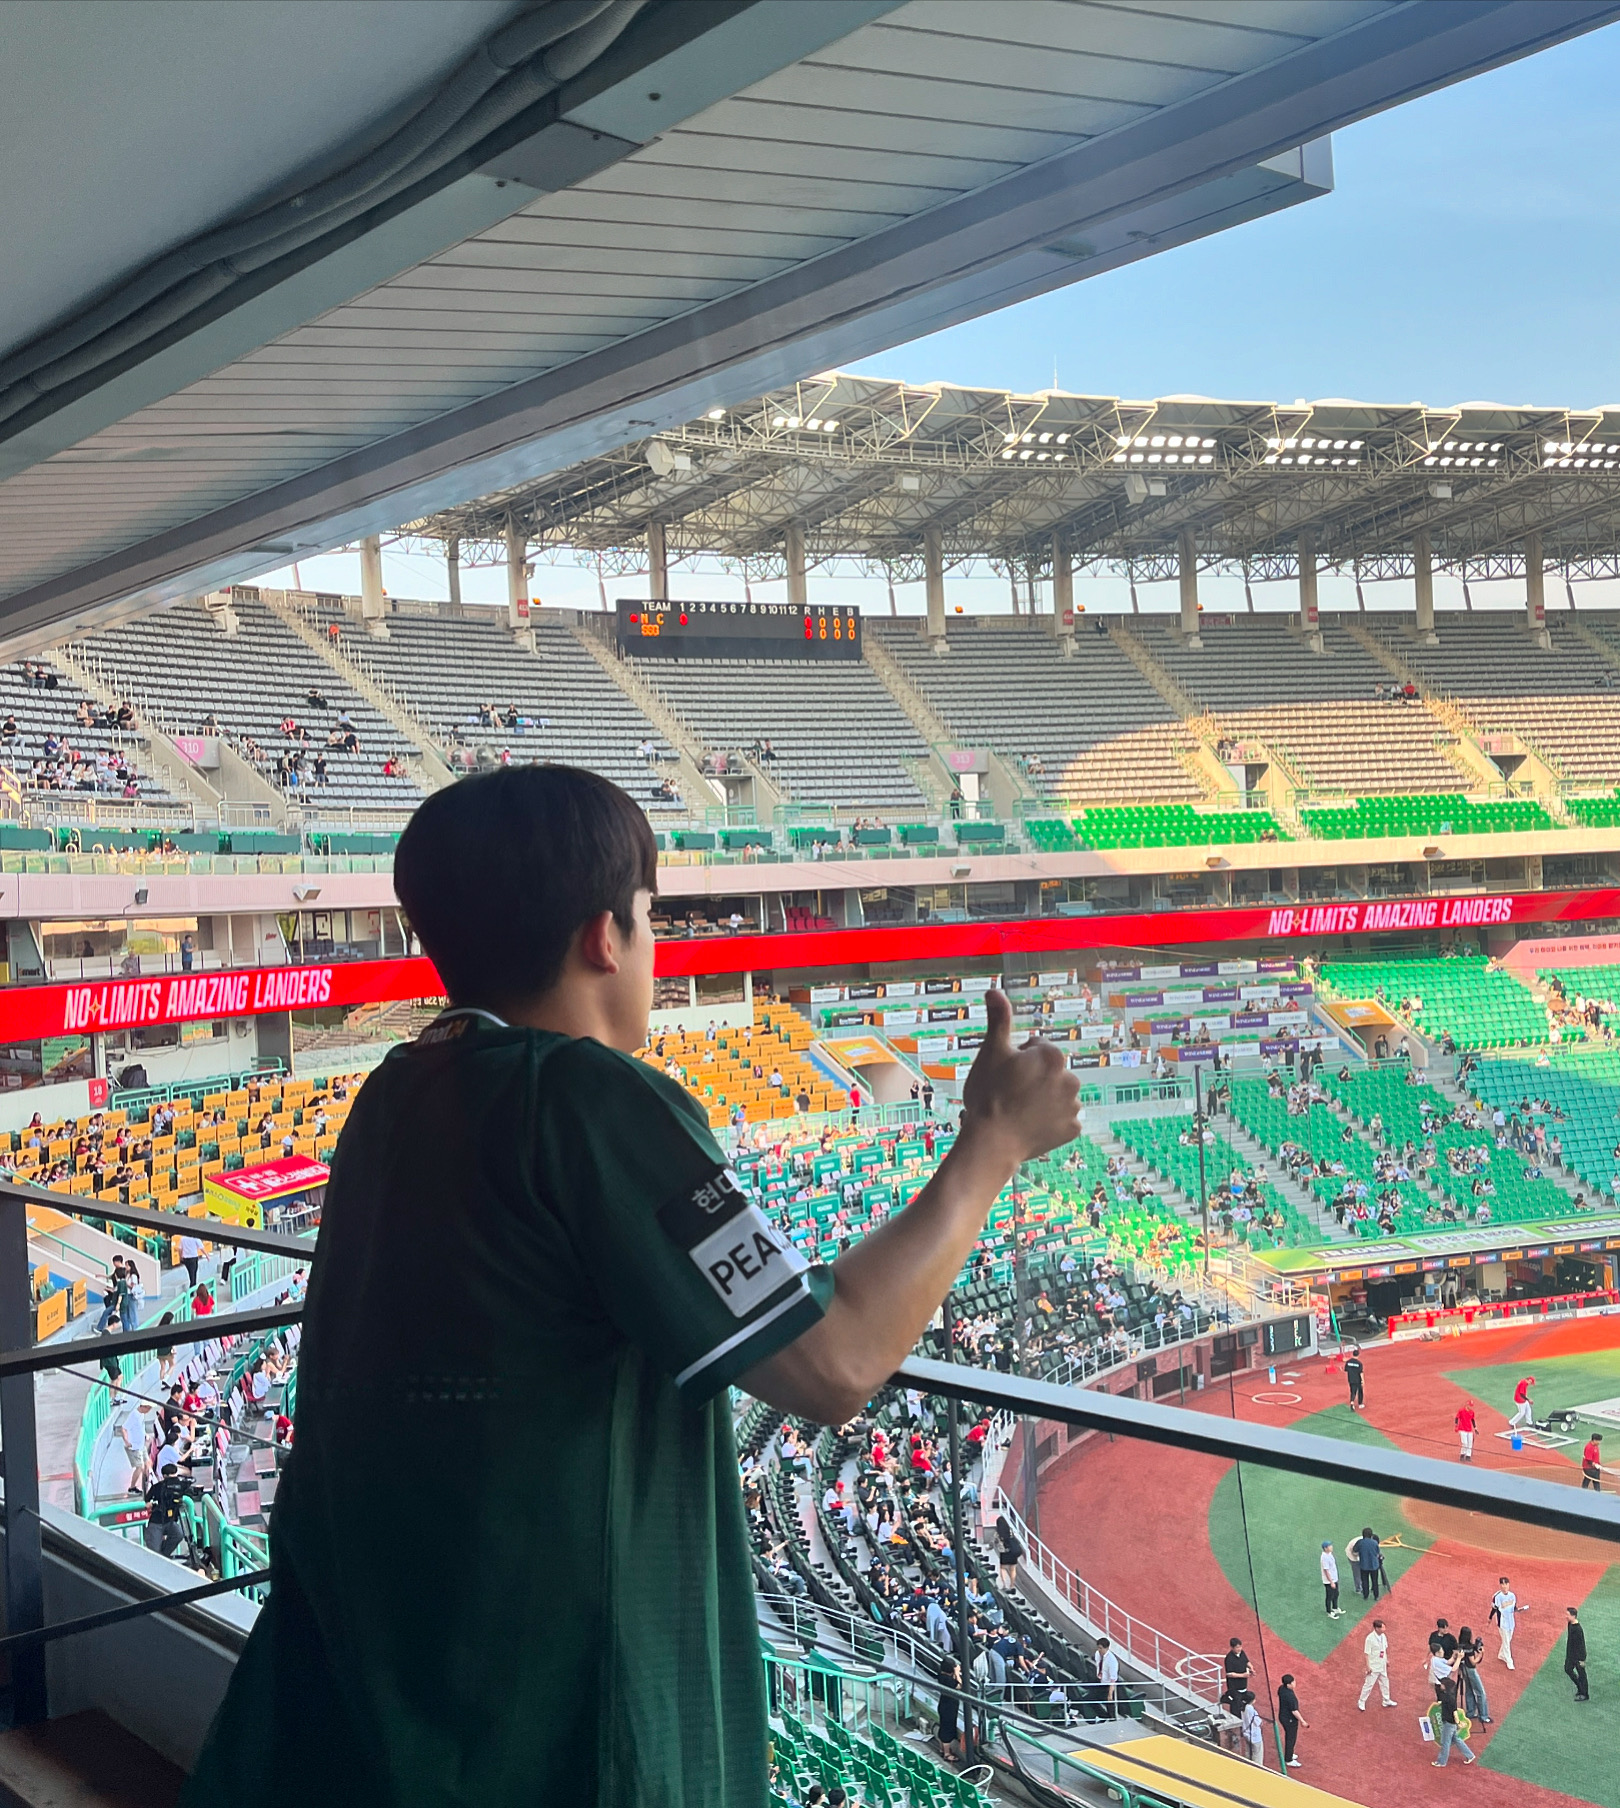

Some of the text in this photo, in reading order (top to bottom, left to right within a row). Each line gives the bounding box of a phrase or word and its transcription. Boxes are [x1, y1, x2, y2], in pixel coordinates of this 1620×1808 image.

[642, 602, 853, 616] TEAM 1 2 3 4 5 6 7 8 9 10 11 12 R H E B
[657, 614, 664, 624] C
[819, 618, 826, 629] 0
[833, 618, 841, 629] 0
[847, 618, 855, 629] 0
[819, 629, 827, 640] 0
[834, 629, 841, 640] 0
[848, 629, 856, 640] 0
[1268, 898, 1513, 935] NO LIMITS AMAZING LANDERS
[64, 969, 332, 1030] NO LIMITS AMAZING LANDERS
[92, 1085, 103, 1097] 18
